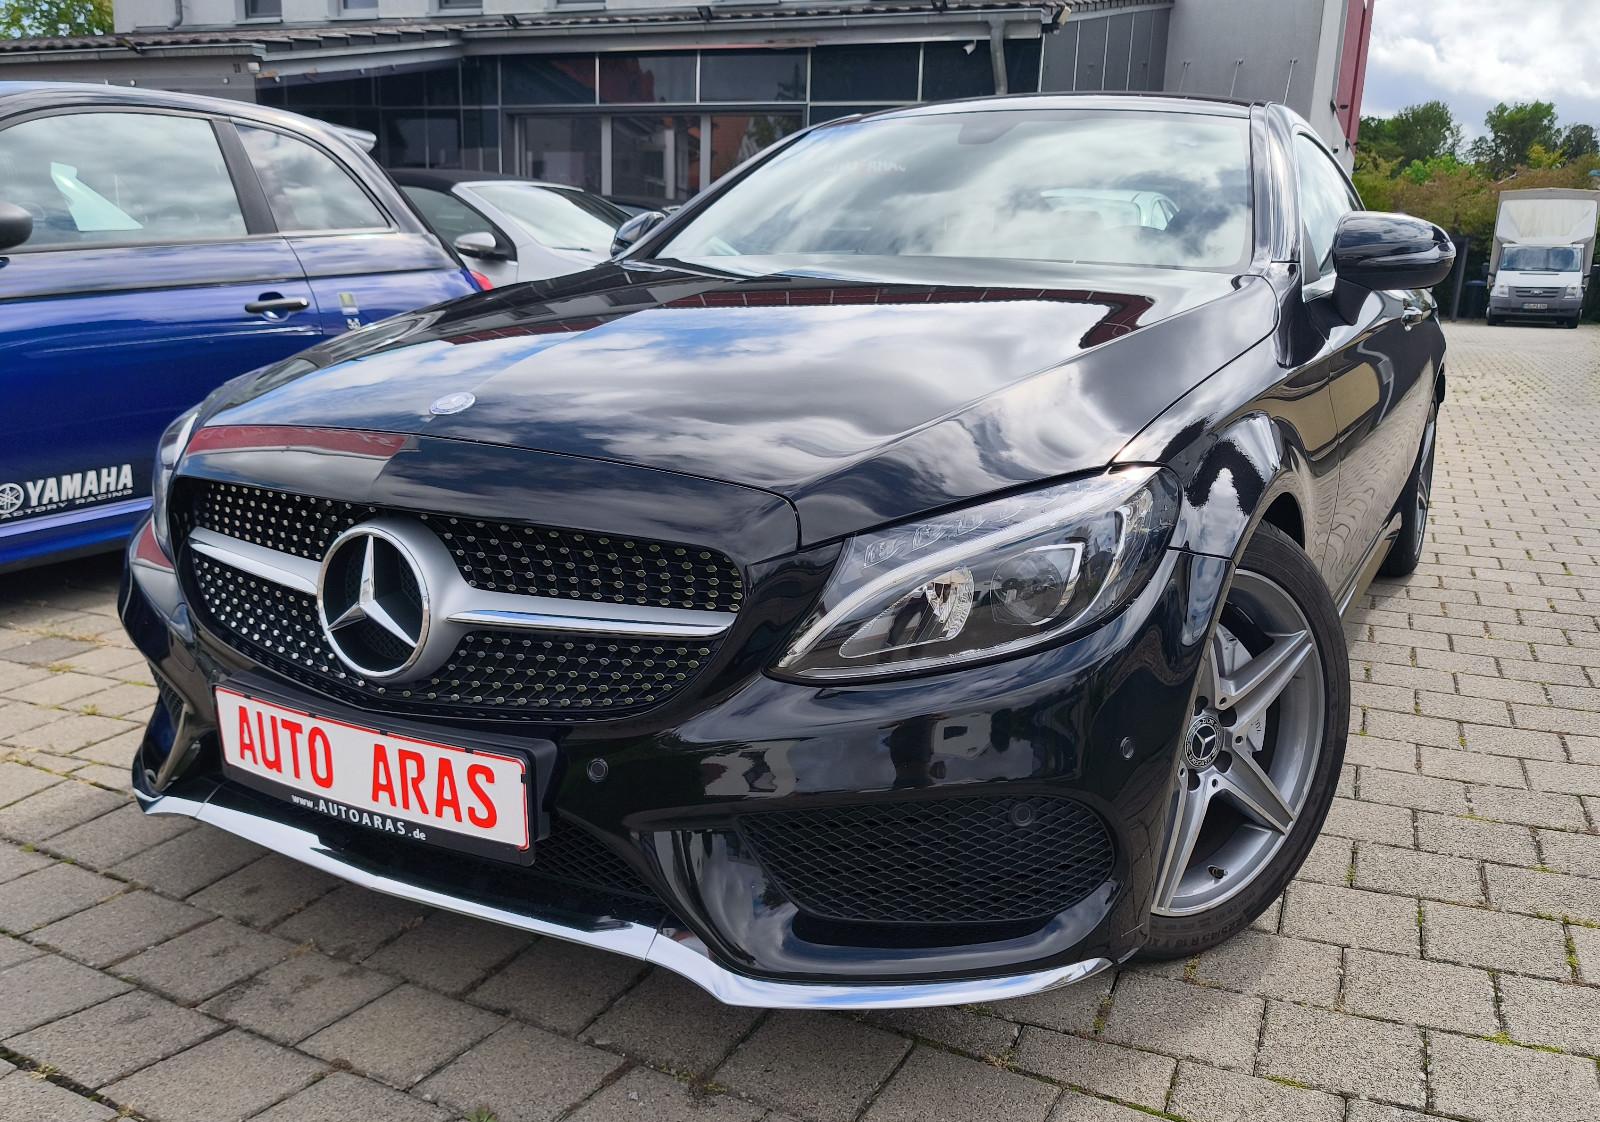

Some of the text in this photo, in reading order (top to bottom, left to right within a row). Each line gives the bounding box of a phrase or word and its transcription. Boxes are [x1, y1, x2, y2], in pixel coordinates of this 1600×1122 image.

[0, 488, 133, 520] ACTORY RACING
[26, 463, 134, 507] YAMAHA
[238, 705, 497, 829] AUTO ARAS
[291, 793, 427, 841] www.AUTOARAS.de
